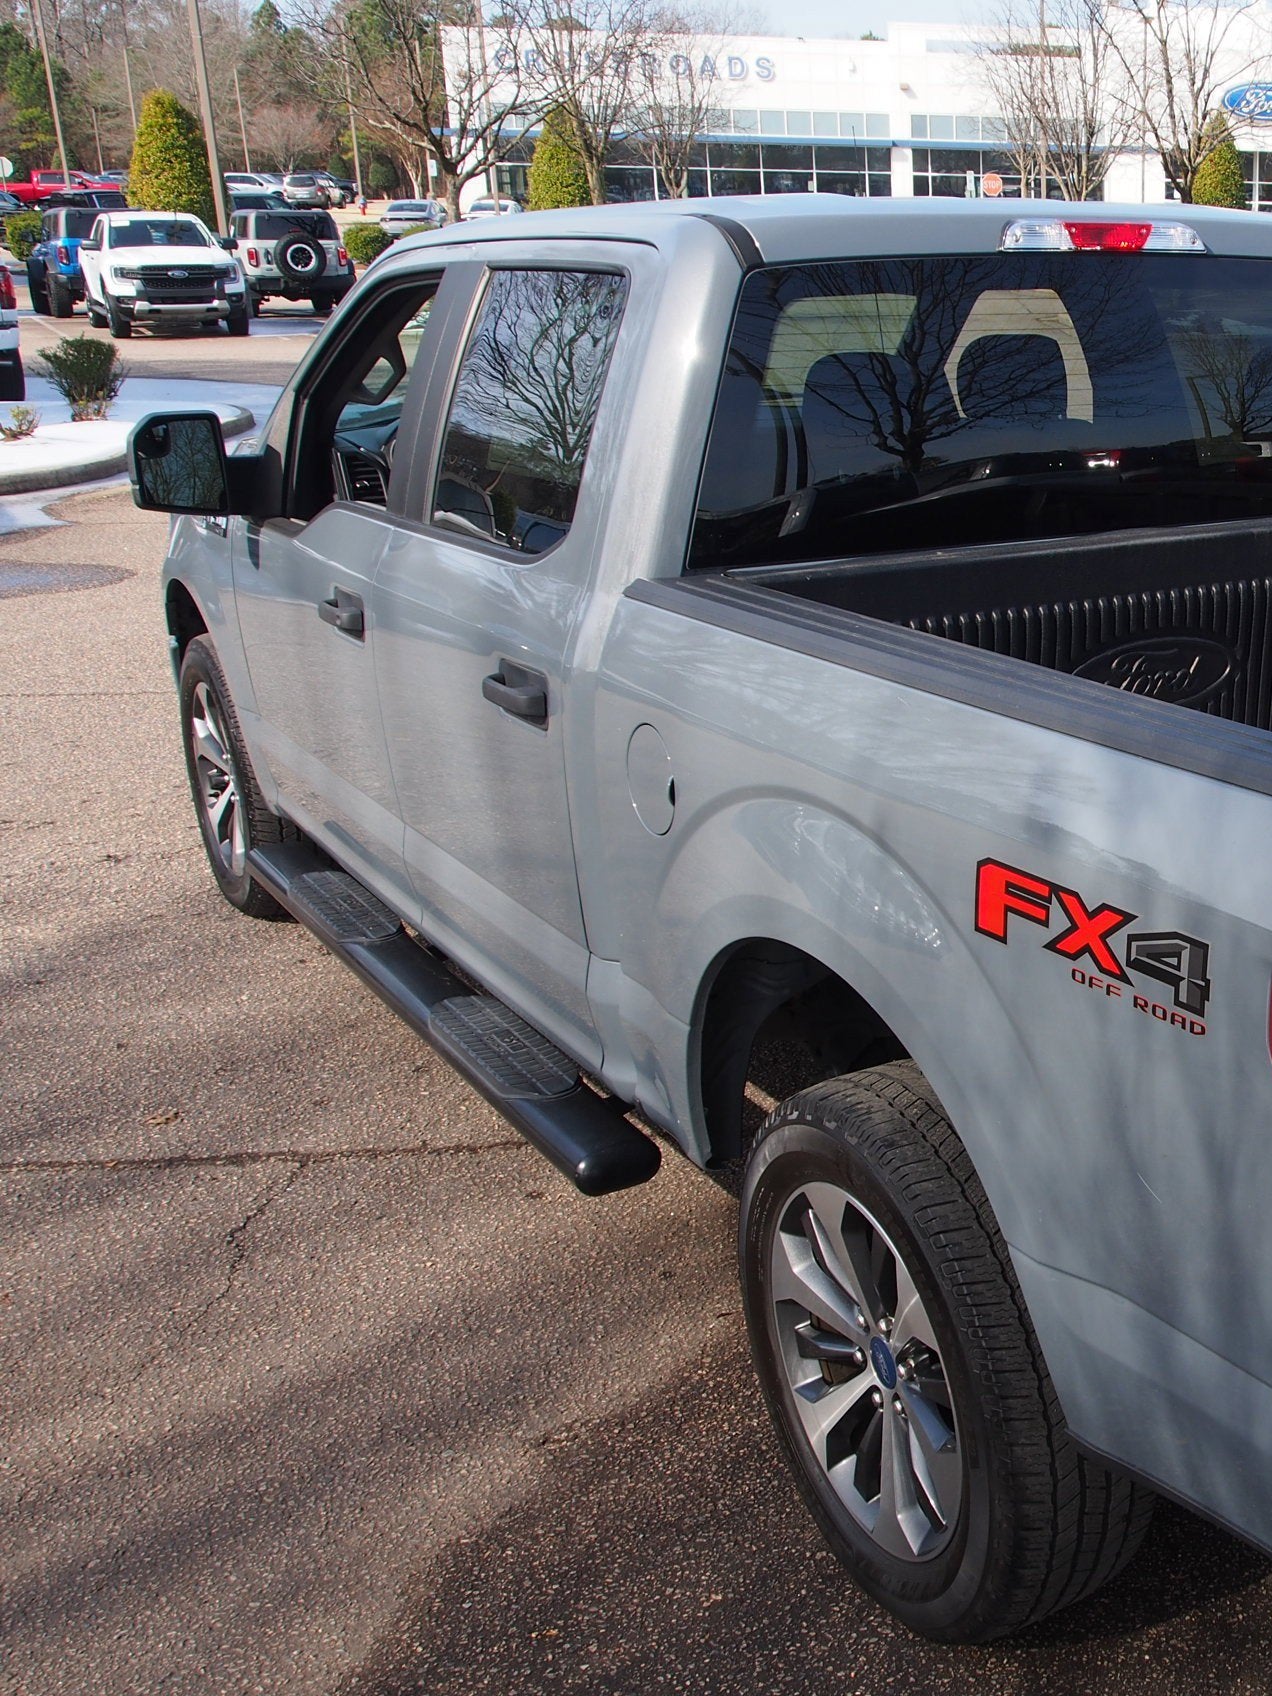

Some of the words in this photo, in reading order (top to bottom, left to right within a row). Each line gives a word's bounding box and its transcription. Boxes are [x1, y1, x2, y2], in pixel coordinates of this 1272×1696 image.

[983, 180, 1000, 189] STOP
[1106, 648, 1201, 696] Ford
[975, 857, 1210, 1018] FX4
[1071, 967, 1121, 998] OFF
[1133, 994, 1206, 1036] ROAD
